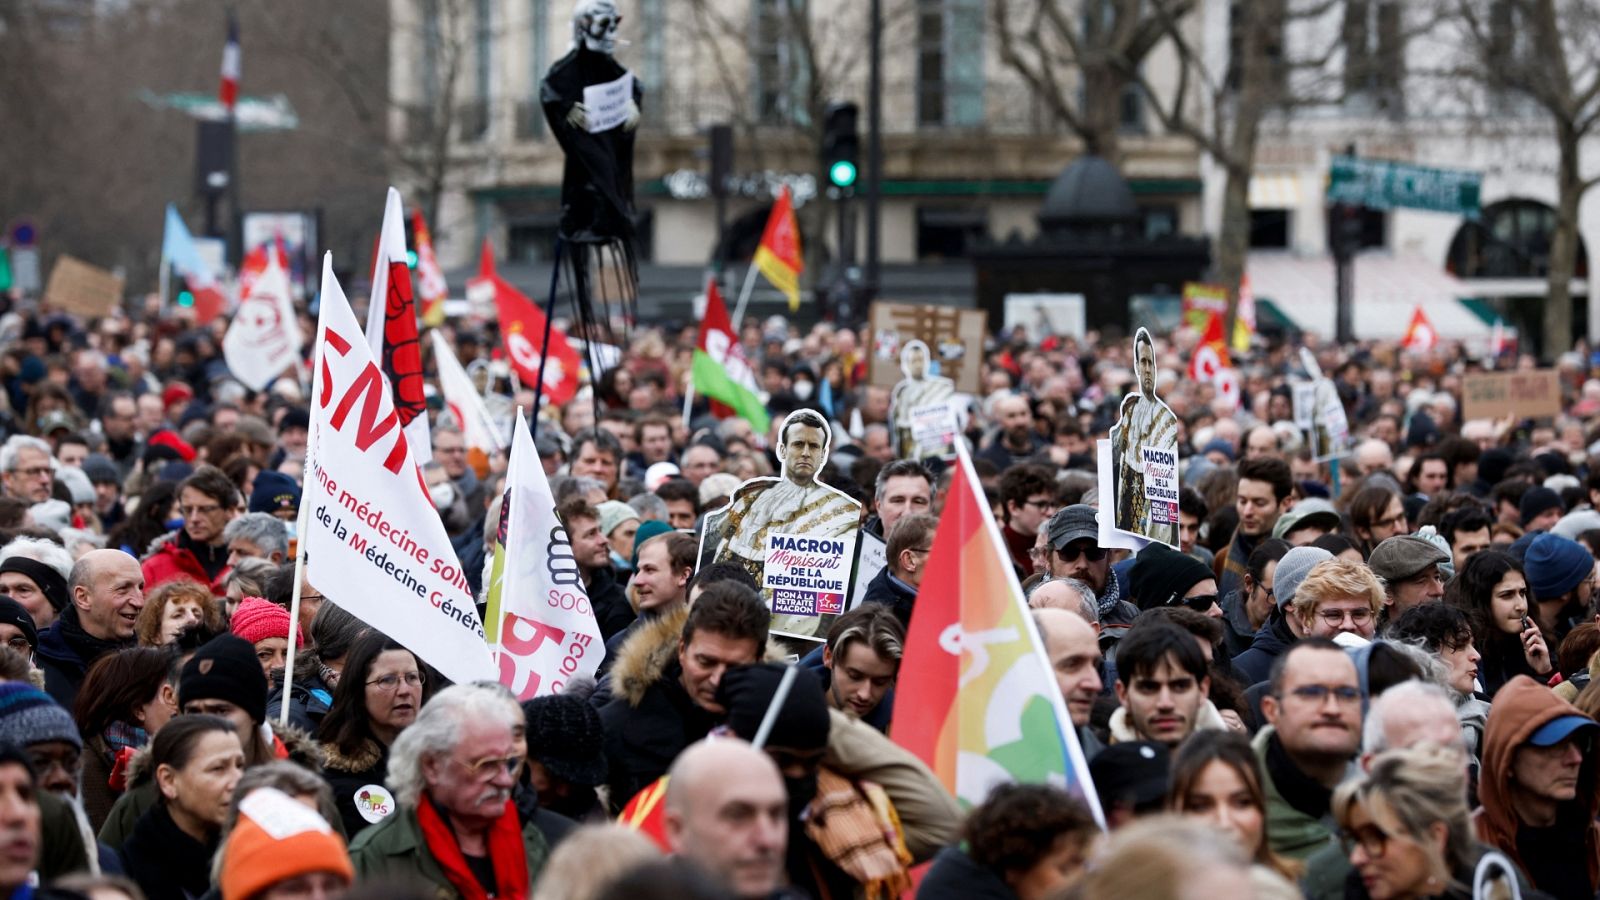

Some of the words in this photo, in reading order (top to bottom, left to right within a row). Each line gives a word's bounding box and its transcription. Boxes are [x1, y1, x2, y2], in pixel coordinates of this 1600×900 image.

[1143, 449, 1175, 466] MACRON
[1155, 478, 1161, 487] DE
[1162, 479, 1168, 488] LA
[1146, 485, 1177, 500] RÉPUBLIQUE
[339, 491, 429, 564] médecine
[771, 536, 844, 555] MACRON
[767, 550, 841, 571] Méprisant
[316, 505, 332, 528] de
[333, 519, 347, 541] la
[349, 533, 427, 598] Médecine
[430, 591, 487, 642] Généra
[791, 567, 805, 576] DE
[807, 568, 822, 578] LA
[767, 574, 842, 590] RÉPUBLIQUE
[776, 591, 796, 601] NON
[796, 590, 803, 600] À
[804, 593, 814, 601] LA
[776, 598, 814, 607] RETRAITE
[548, 590, 594, 618] SOCI
[775, 605, 814, 614] MACRON
[372, 802, 388, 815] PS
